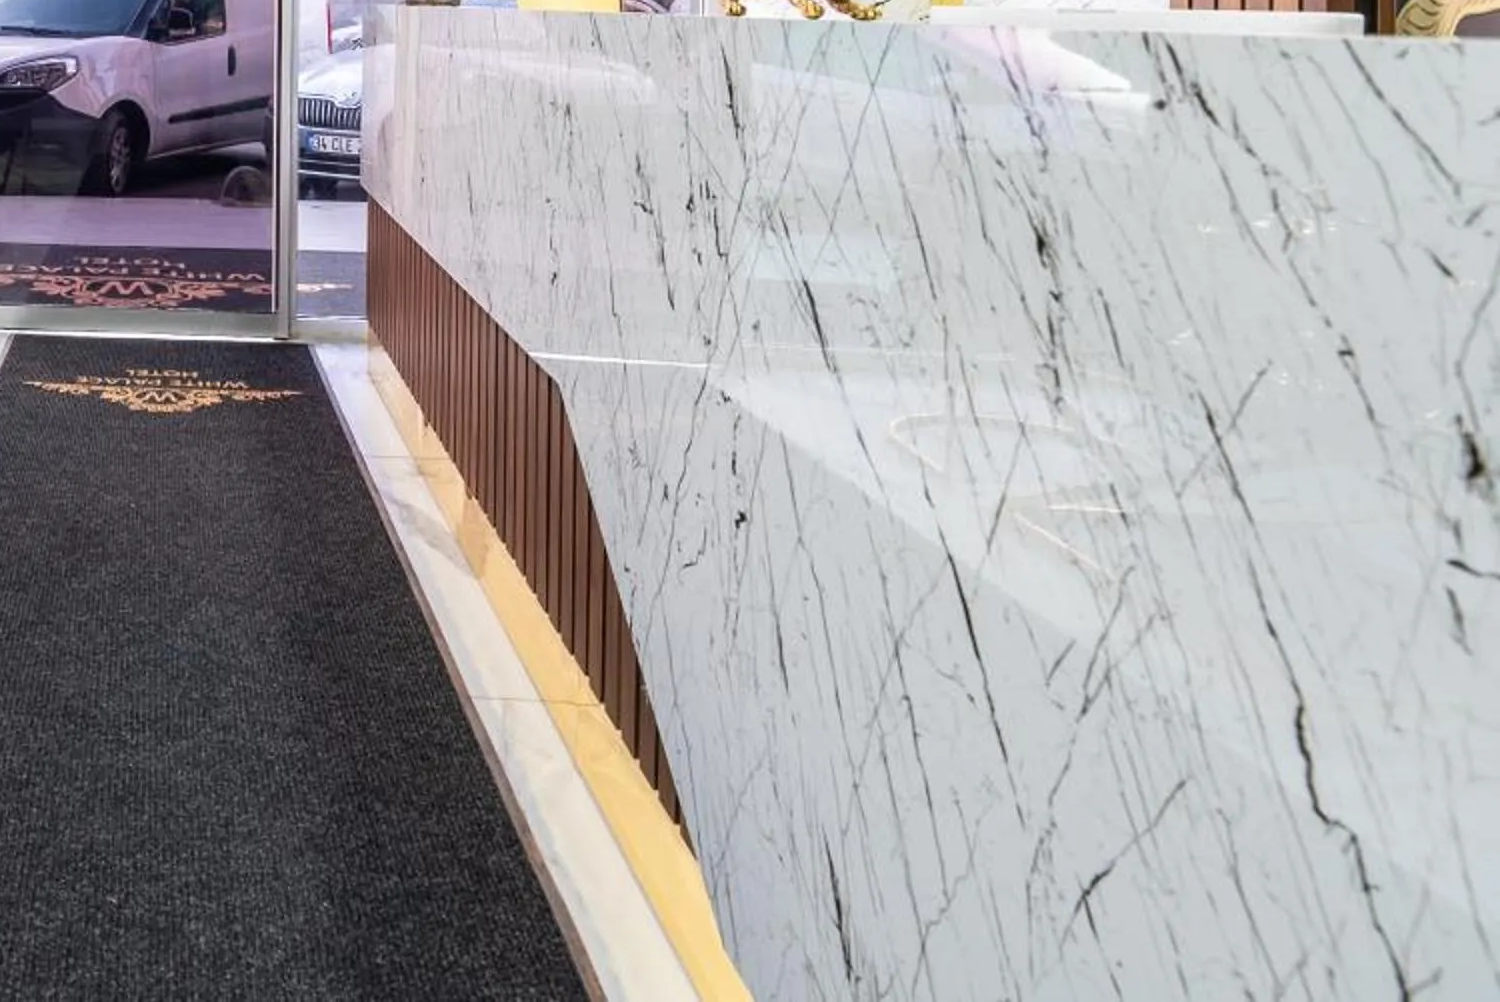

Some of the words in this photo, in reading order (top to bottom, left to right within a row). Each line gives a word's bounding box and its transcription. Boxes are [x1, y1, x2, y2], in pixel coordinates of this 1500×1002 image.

[75, 257, 185, 269] HOTEL
[141, 268, 265, 280] WHITE
[100, 281, 154, 295] W
[126, 369, 199, 378] HOTEL
[76, 376, 161, 387] PALACE
[174, 379, 248, 388] WHITE
[146, 390, 177, 401] W
